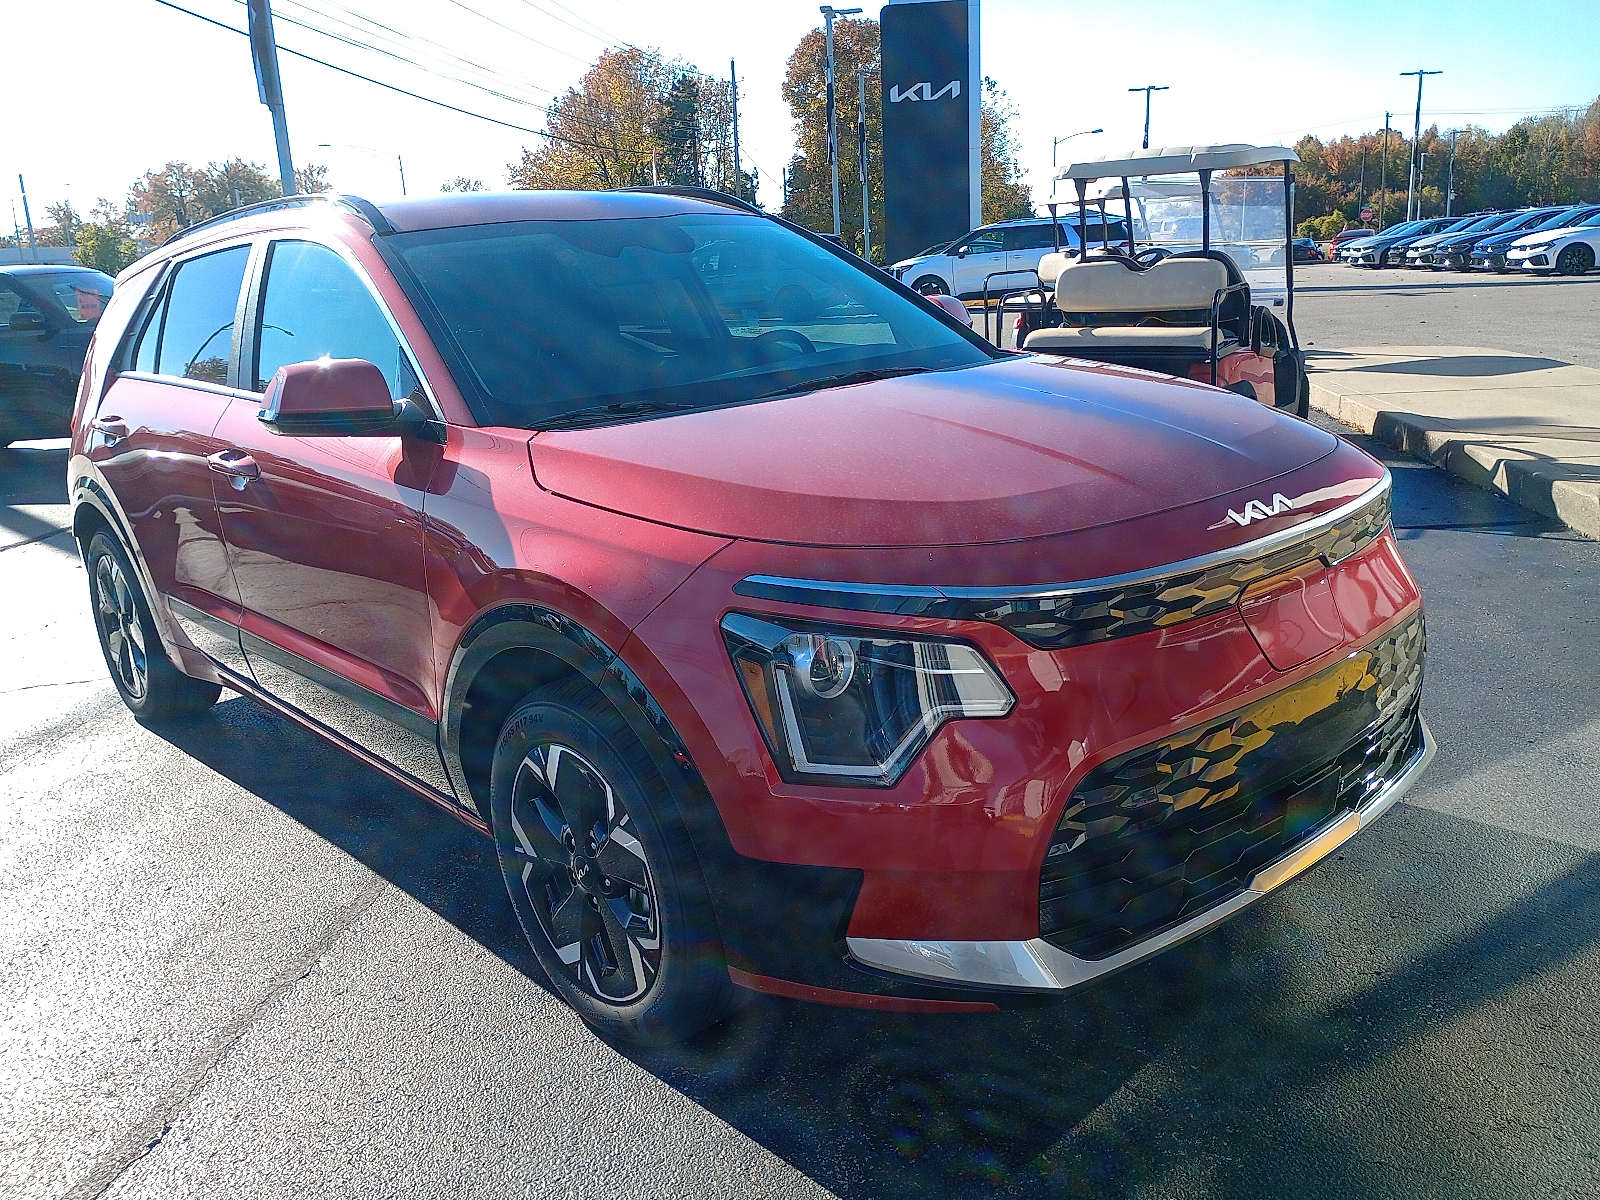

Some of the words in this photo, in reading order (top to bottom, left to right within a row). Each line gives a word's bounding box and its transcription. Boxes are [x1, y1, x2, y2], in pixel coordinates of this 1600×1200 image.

[889, 80, 961, 103] KIA
[1227, 492, 1294, 527] KIA
[528, 713, 544, 724] 94V
